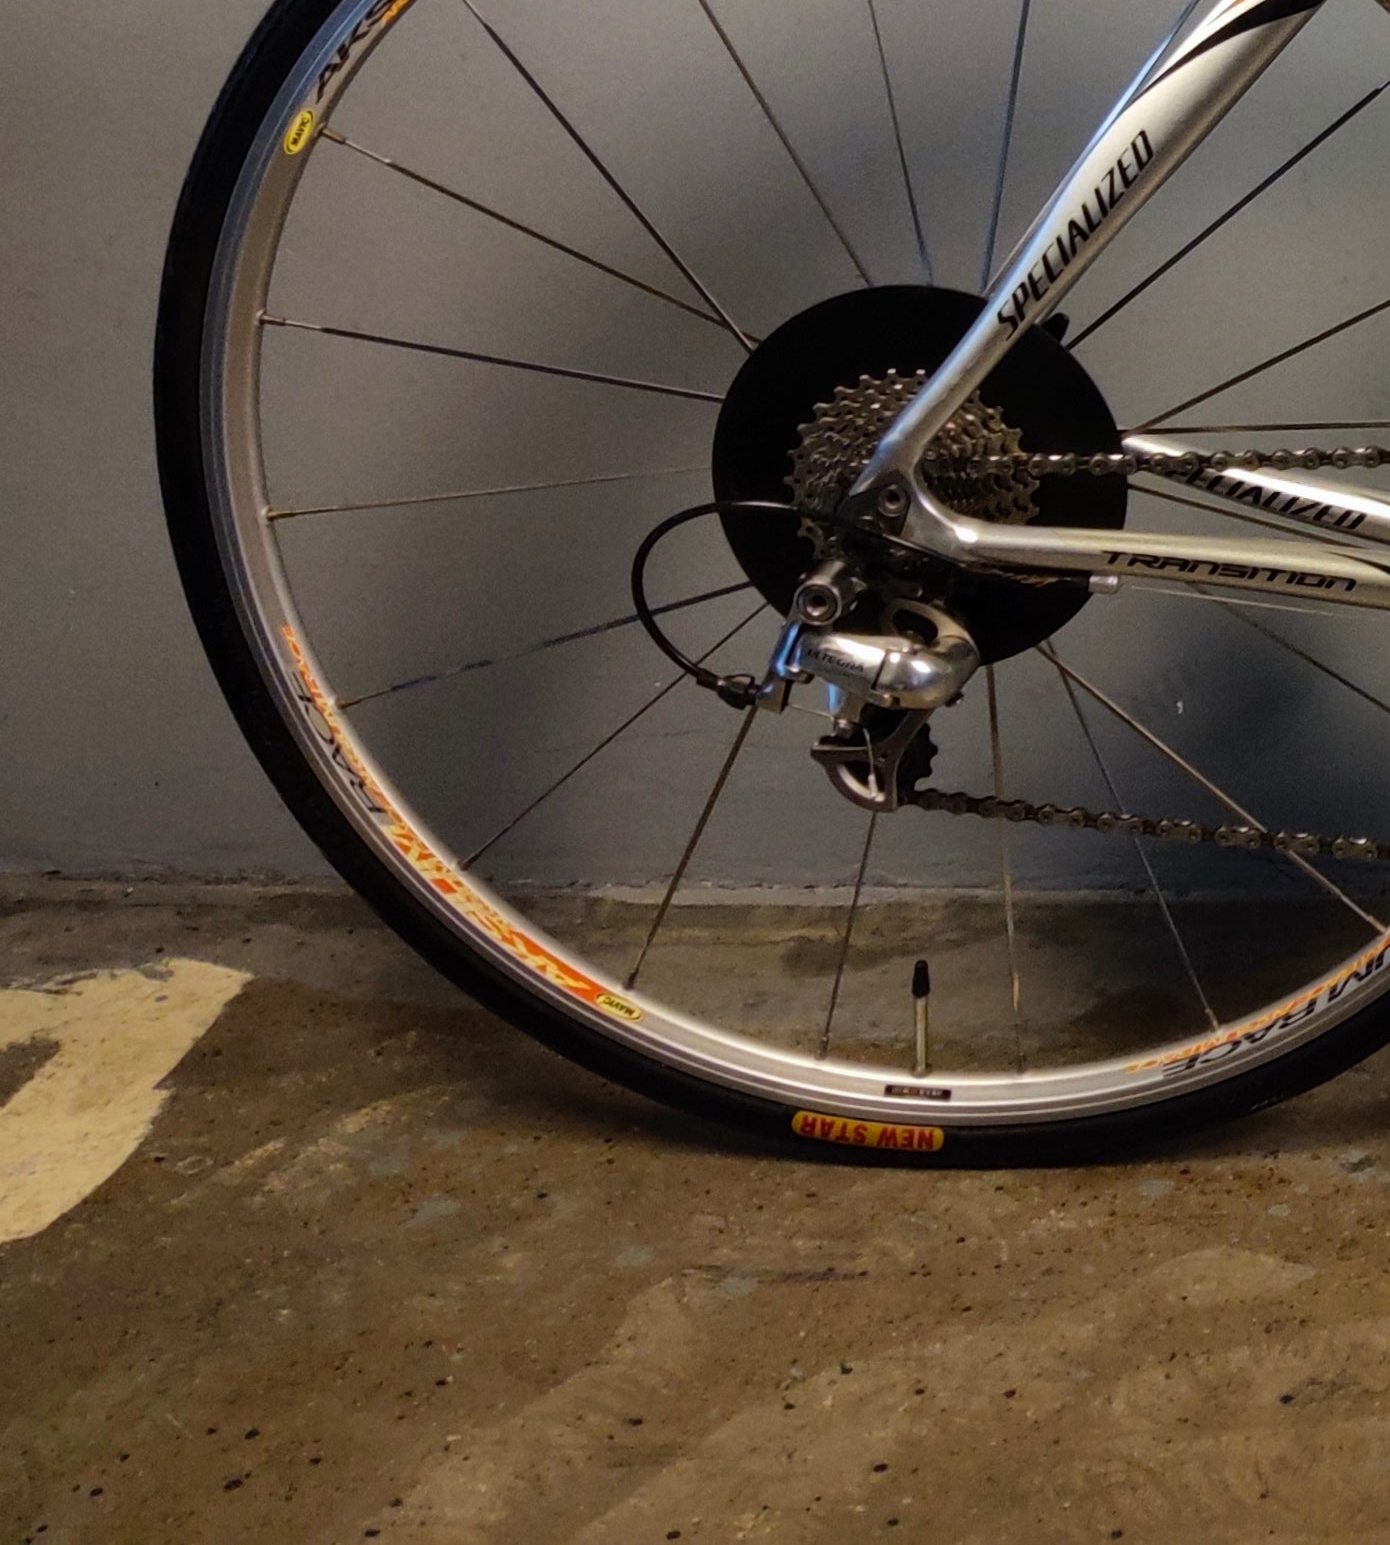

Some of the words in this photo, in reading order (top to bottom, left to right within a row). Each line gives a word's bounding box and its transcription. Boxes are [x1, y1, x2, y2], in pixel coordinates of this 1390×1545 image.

[997, 129, 1155, 341] SPECIALIZED
[1101, 550, 1357, 592] TRANSITION
[800, 1115, 867, 1145] STAR
[877, 1124, 935, 1151] NEW
